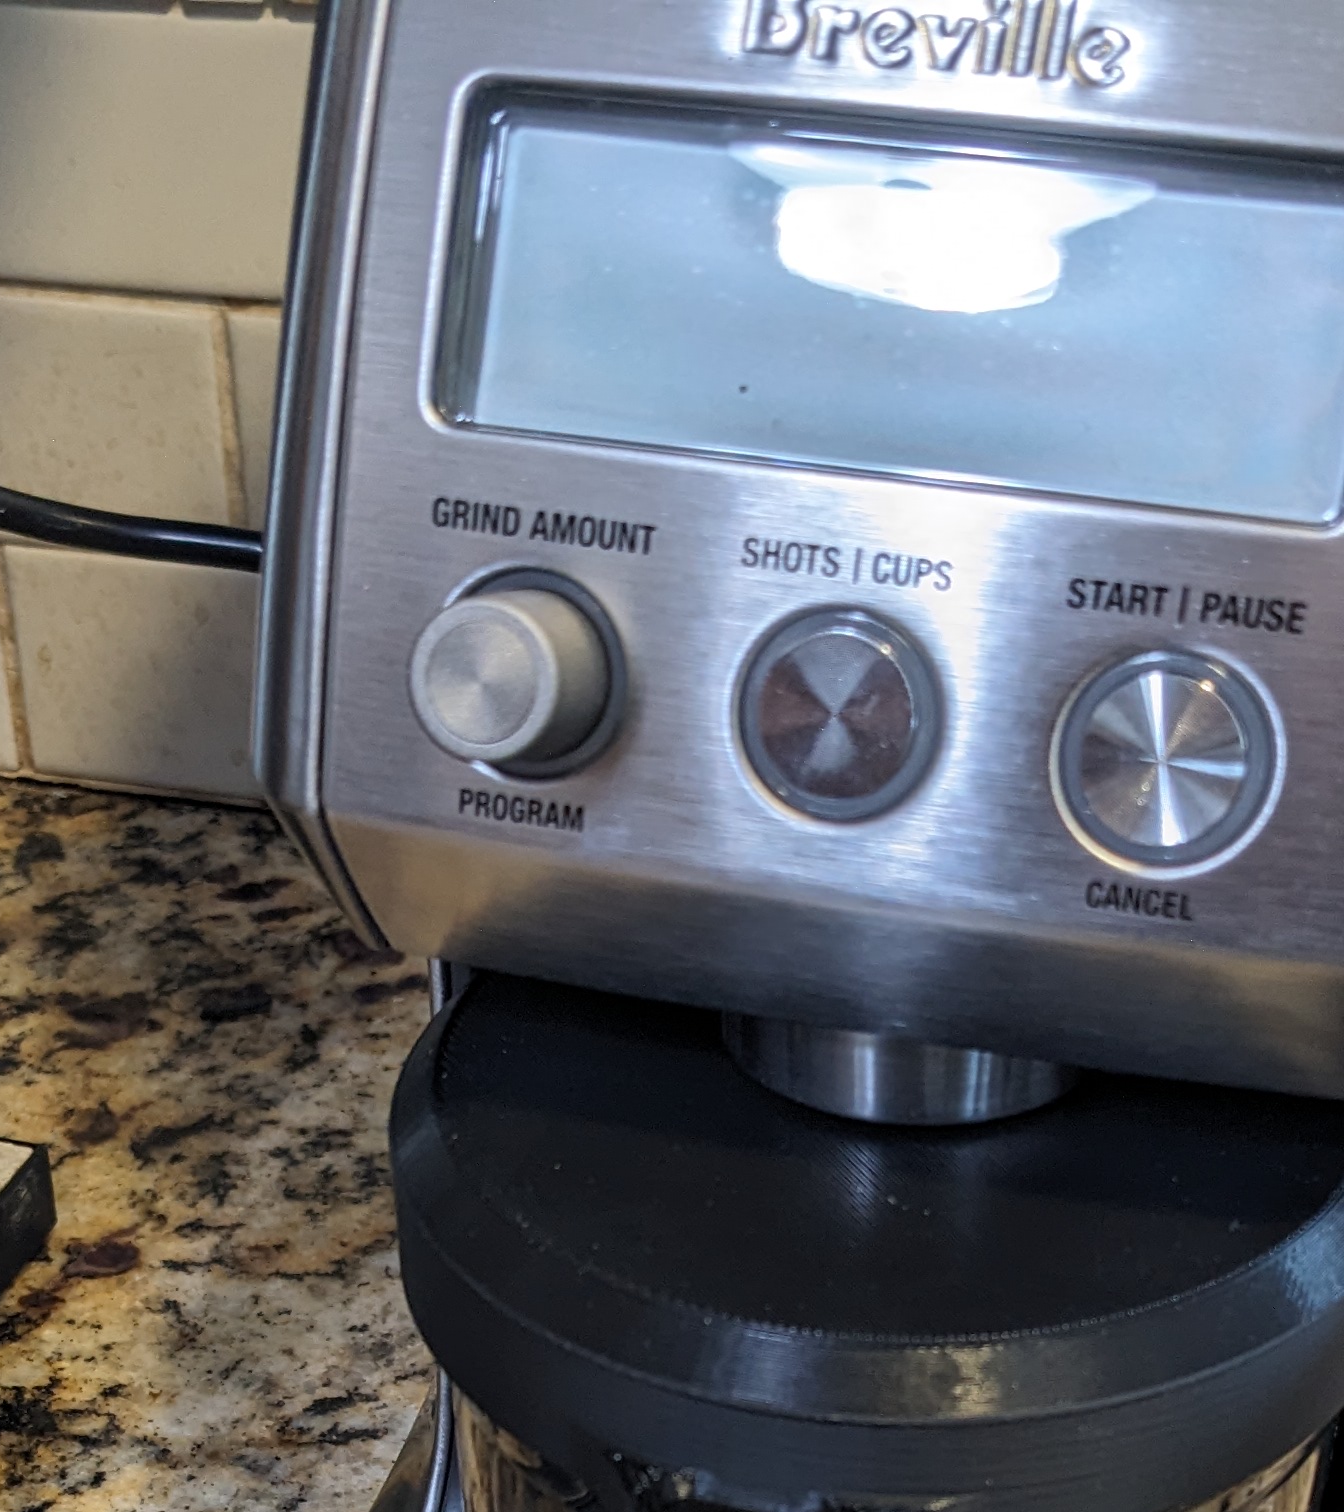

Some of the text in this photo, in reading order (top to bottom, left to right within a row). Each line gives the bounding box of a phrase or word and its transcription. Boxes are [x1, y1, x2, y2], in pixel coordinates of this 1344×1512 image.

[742, 0, 1131, 87] Breville
[432, 498, 656, 554] GRIND AMOUNT
[741, 537, 840, 578] SHOTS
[871, 553, 953, 592] CUPS
[1066, 578, 1168, 617] START
[1200, 592, 1308, 634] PAUSE
[458, 789, 585, 832] PROGRAM
[1085, 881, 1193, 921] CANCEL
